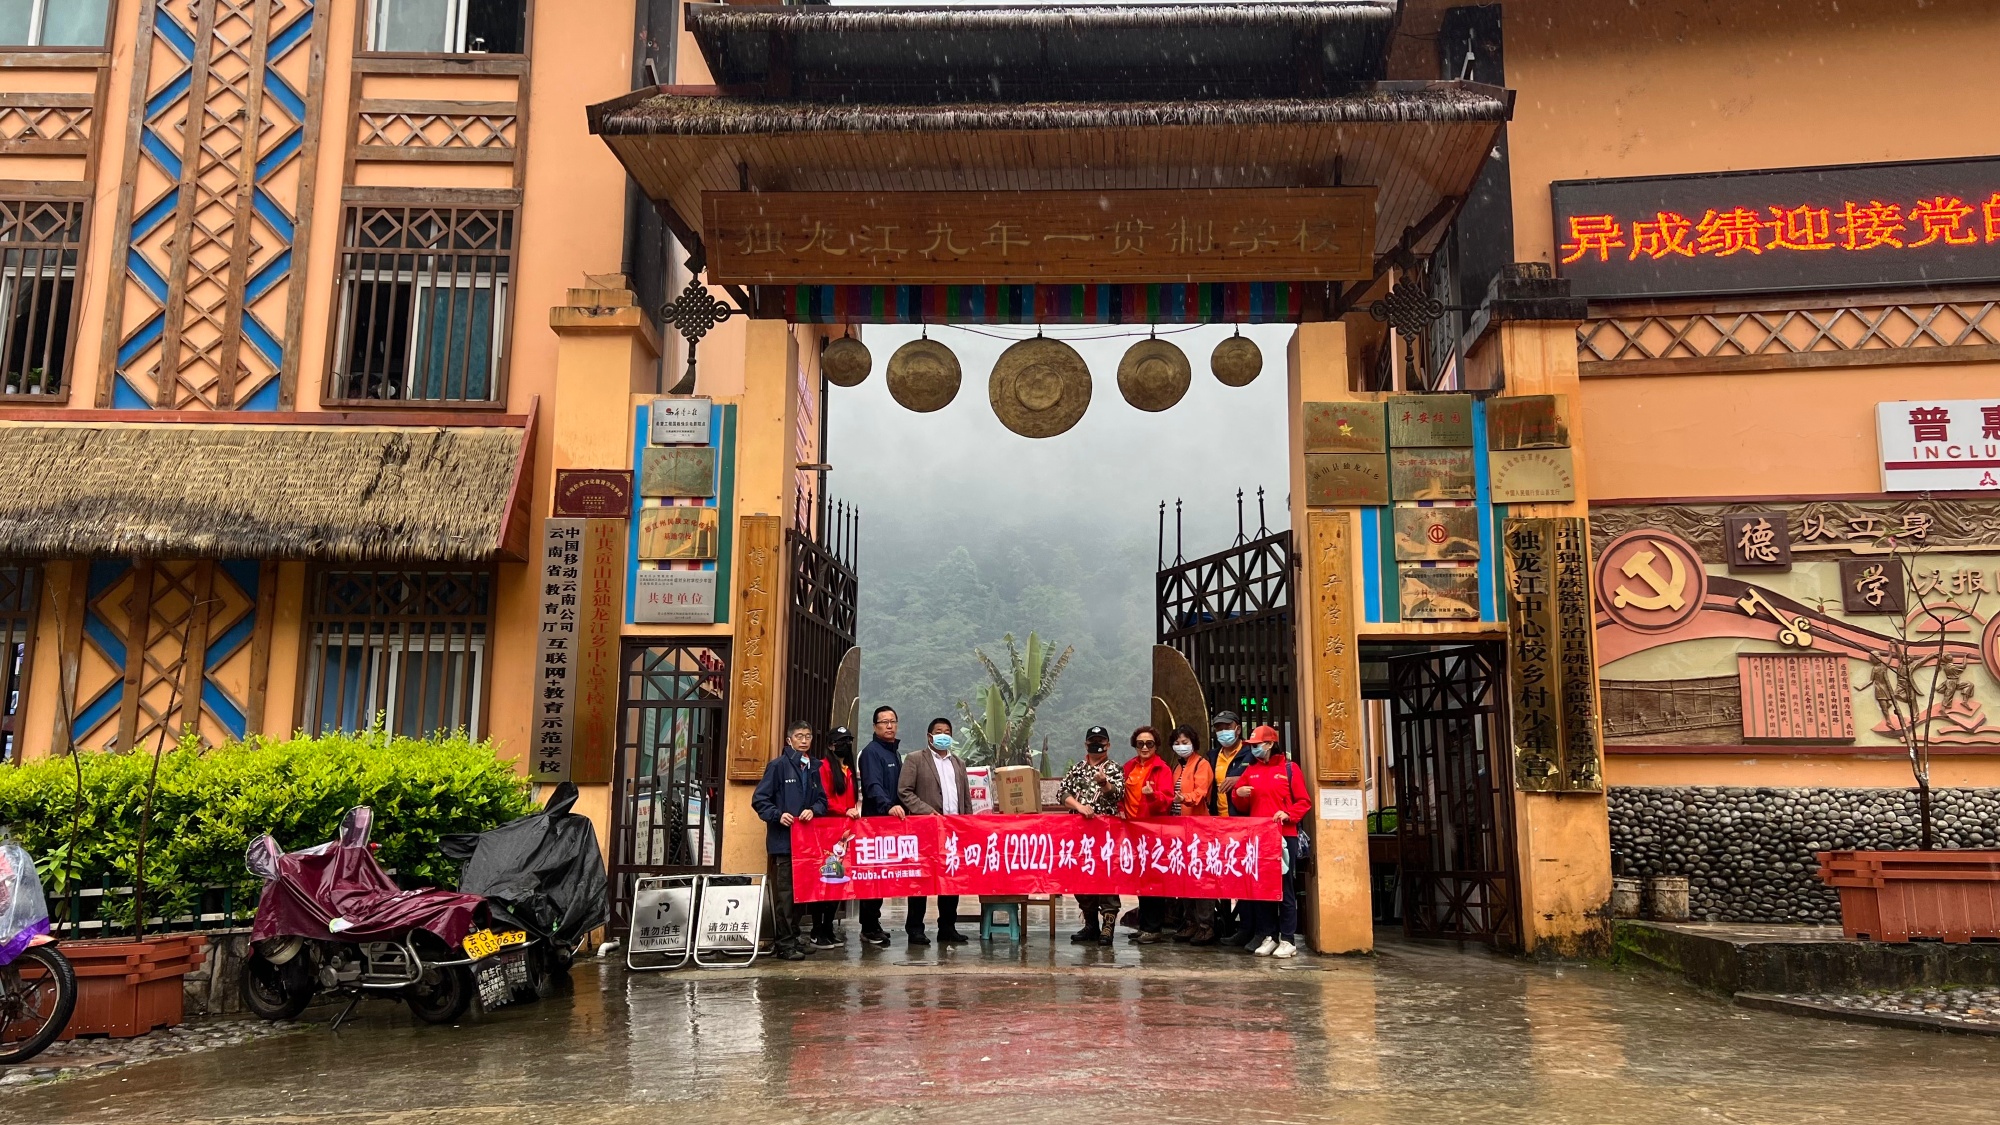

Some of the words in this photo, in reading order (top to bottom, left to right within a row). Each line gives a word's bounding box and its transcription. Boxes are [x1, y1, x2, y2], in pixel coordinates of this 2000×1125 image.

[735, 219, 1340, 257] 独龙江九年一贯制学校
[1401, 410, 1461, 426] 平安校园
[1912, 445, 1998, 460] INCLU
[542, 527, 564, 632] 云南省教育厅
[560, 527, 580, 632] 中国移动云南公司
[648, 592, 703, 605] 共建单位
[583, 524, 614, 779] 中共贡山县独龙江乡中心学校支
[1511, 530, 1552, 778] 独龙江中心校乡村少年宫
[538, 637, 568, 773] 互联网+教育示范学校
[1324, 797, 1358, 807] 随手关门
[855, 834, 919, 865] 走吧网
[944, 830, 1260, 882] 第四届(2022)环驾中国梦之旅高端定制
[640, 925, 681, 936] 请勿泊车
[708, 922, 750, 932] 请勿泊车
[496, 933, 524, 946] 0639
[638, 938, 649, 947] NO
[650, 936, 680, 946] PARKING
[706, 934, 717, 942] NO
[718, 933, 748, 942] PARKING
